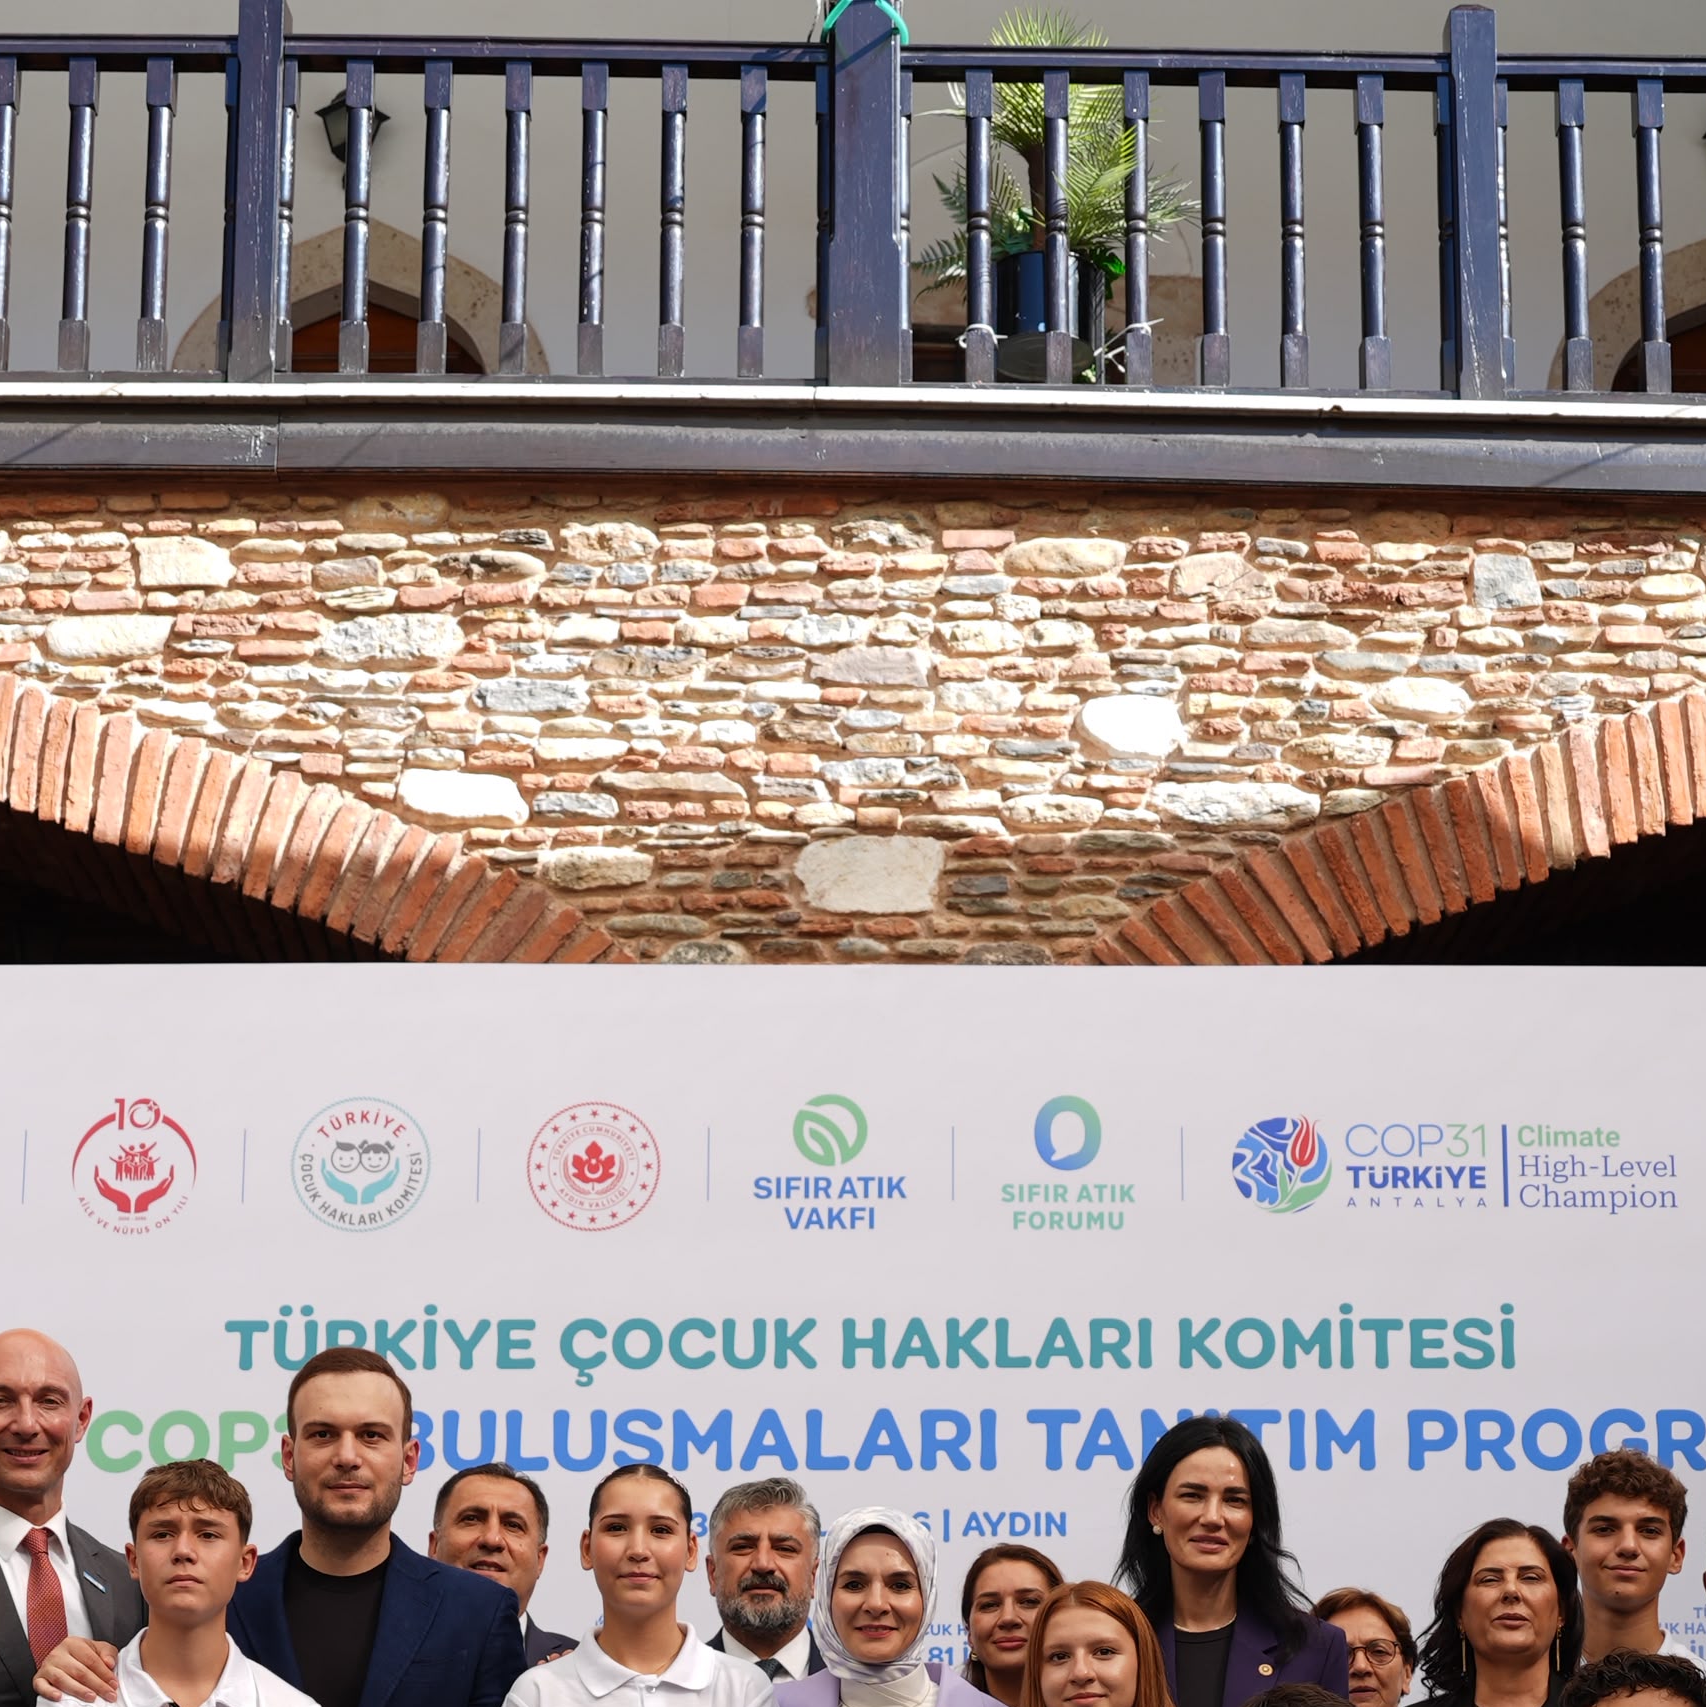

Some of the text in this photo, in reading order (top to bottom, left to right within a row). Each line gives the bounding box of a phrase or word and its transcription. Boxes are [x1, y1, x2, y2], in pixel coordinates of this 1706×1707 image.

[317, 1108, 407, 1139] TÜRKİYE
[1519, 1126, 1619, 1146] Climate
[1345, 1123, 1485, 1158] COP31
[1520, 1155, 1676, 1183] High-Level
[299, 1152, 422, 1226] ÇOCUK HAKLARI KOMİTESİ
[754, 1176, 906, 1199] SIFIR ATIK
[1002, 1184, 1134, 1202] SIFIR ATIK
[1349, 1196, 1485, 1207] ANTALYA
[1519, 1184, 1678, 1215] Champion
[96, 1217, 109, 1229] VE
[113, 1225, 150, 1235] NÜFUS
[155, 1216, 171, 1229] ON
[172, 1195, 189, 1215] YILI
[785, 1207, 875, 1229] VAKFI
[1014, 1212, 1124, 1229] FORUMU
[560, 1318, 817, 1387] ÇOCUK
[842, 1317, 1152, 1369] HAKLARI
[1179, 1303, 1515, 1369] KOMİTESİ
[1027, 1408, 1377, 1471] TANTIM
[963, 1511, 1067, 1537] AYDIN
